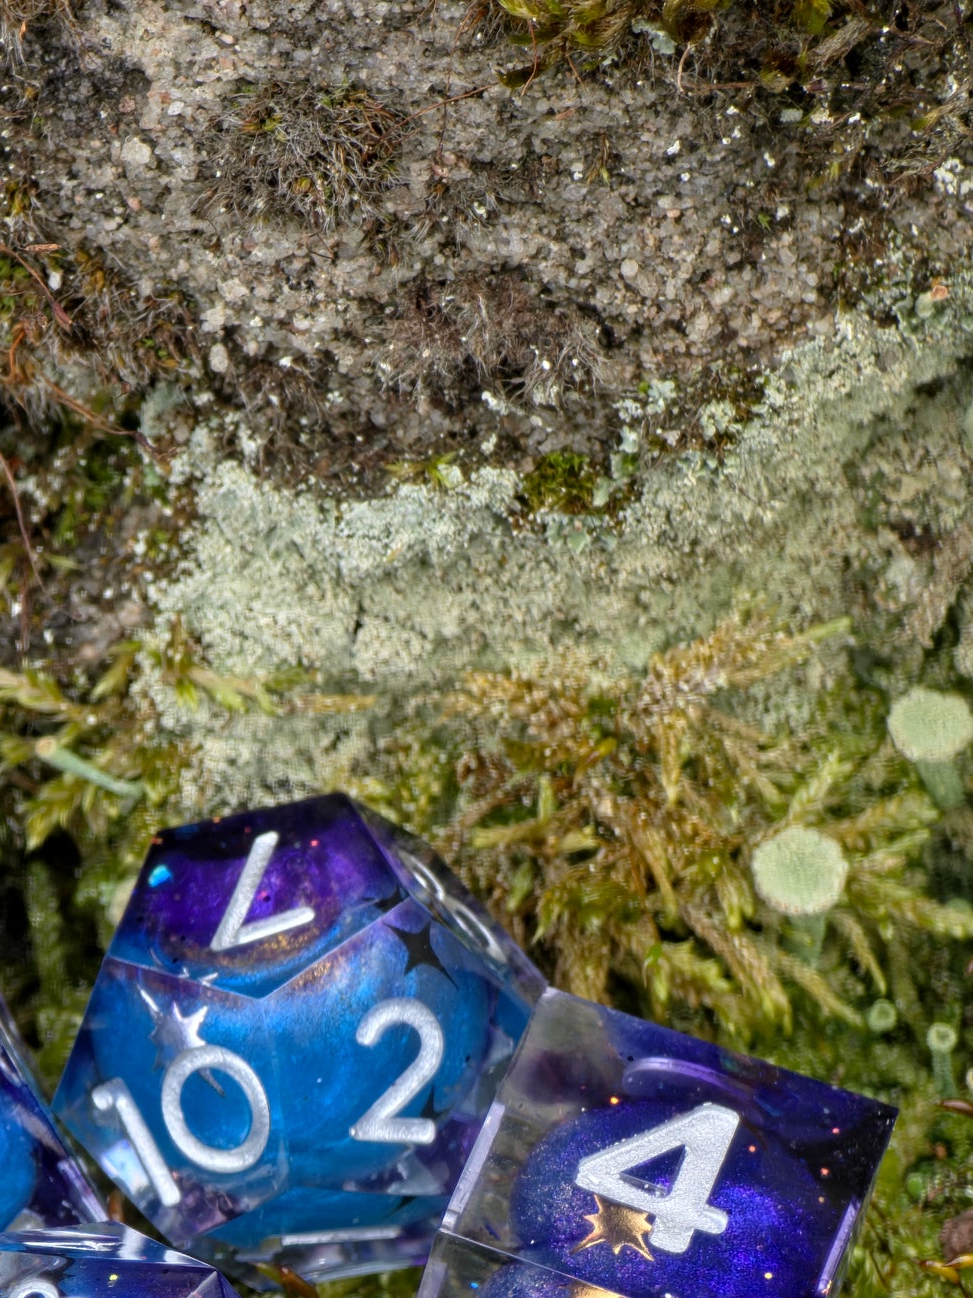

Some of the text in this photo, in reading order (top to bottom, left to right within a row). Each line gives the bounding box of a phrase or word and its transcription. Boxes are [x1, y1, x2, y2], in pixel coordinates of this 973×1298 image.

[92, 1045, 271, 1206] 10
[349, 999, 444, 1144] 2
[575, 1102, 740, 1254] 4
